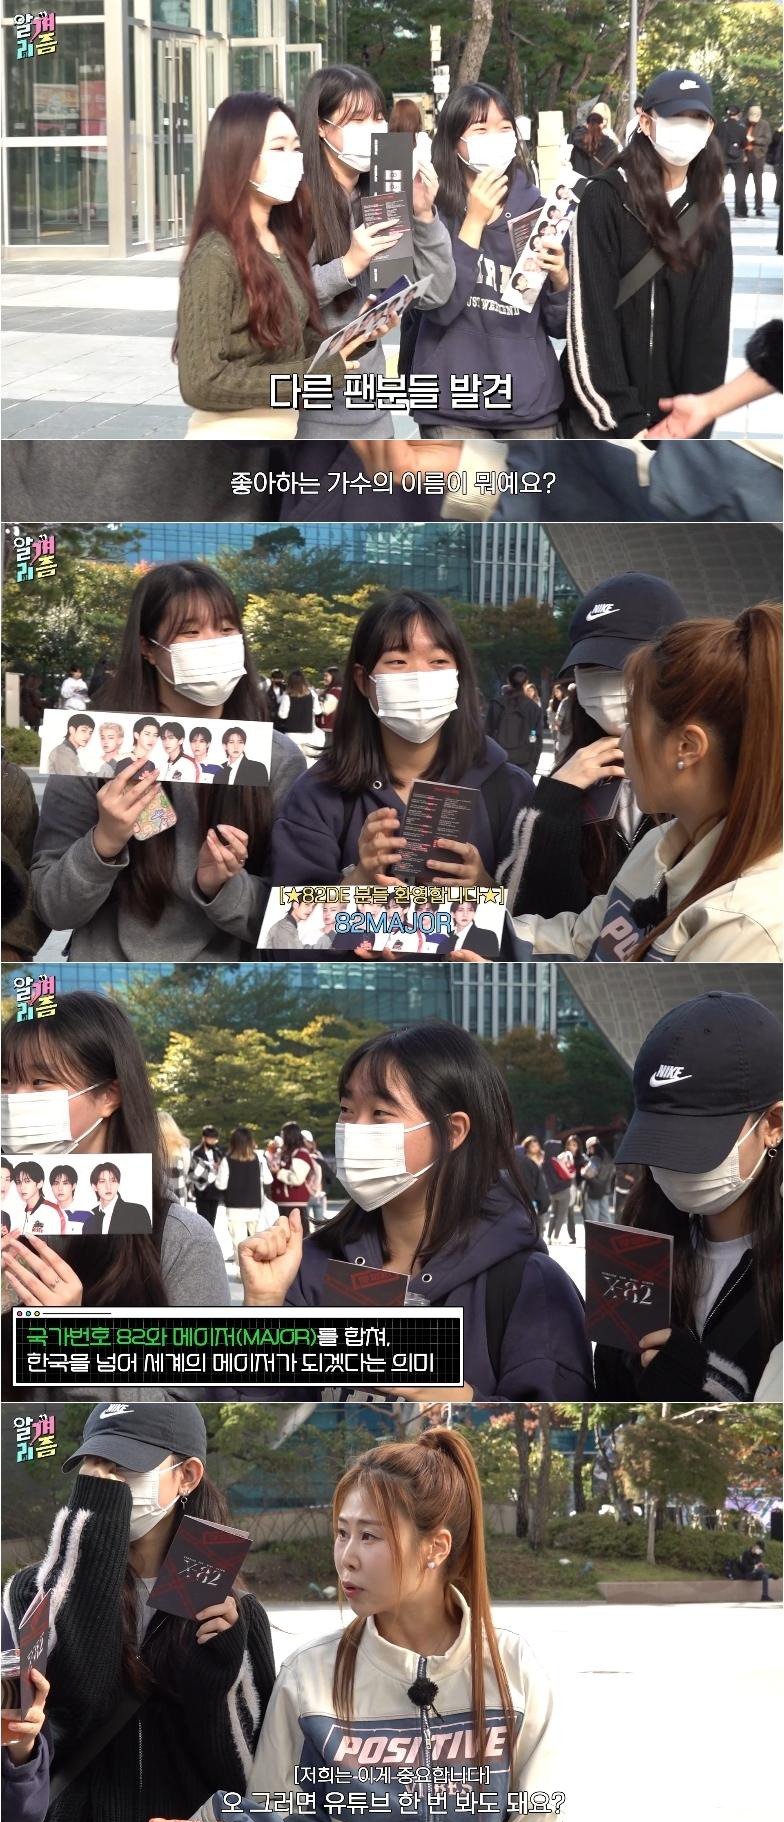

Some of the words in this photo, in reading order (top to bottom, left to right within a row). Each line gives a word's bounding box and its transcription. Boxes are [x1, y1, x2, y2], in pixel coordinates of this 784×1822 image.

[591, 603, 616, 614] NIKE
[656, 1064, 685, 1079] NIKE
[107, 1404, 130, 1413] NIKE
[333, 1725, 508, 1765] POSITIVE
